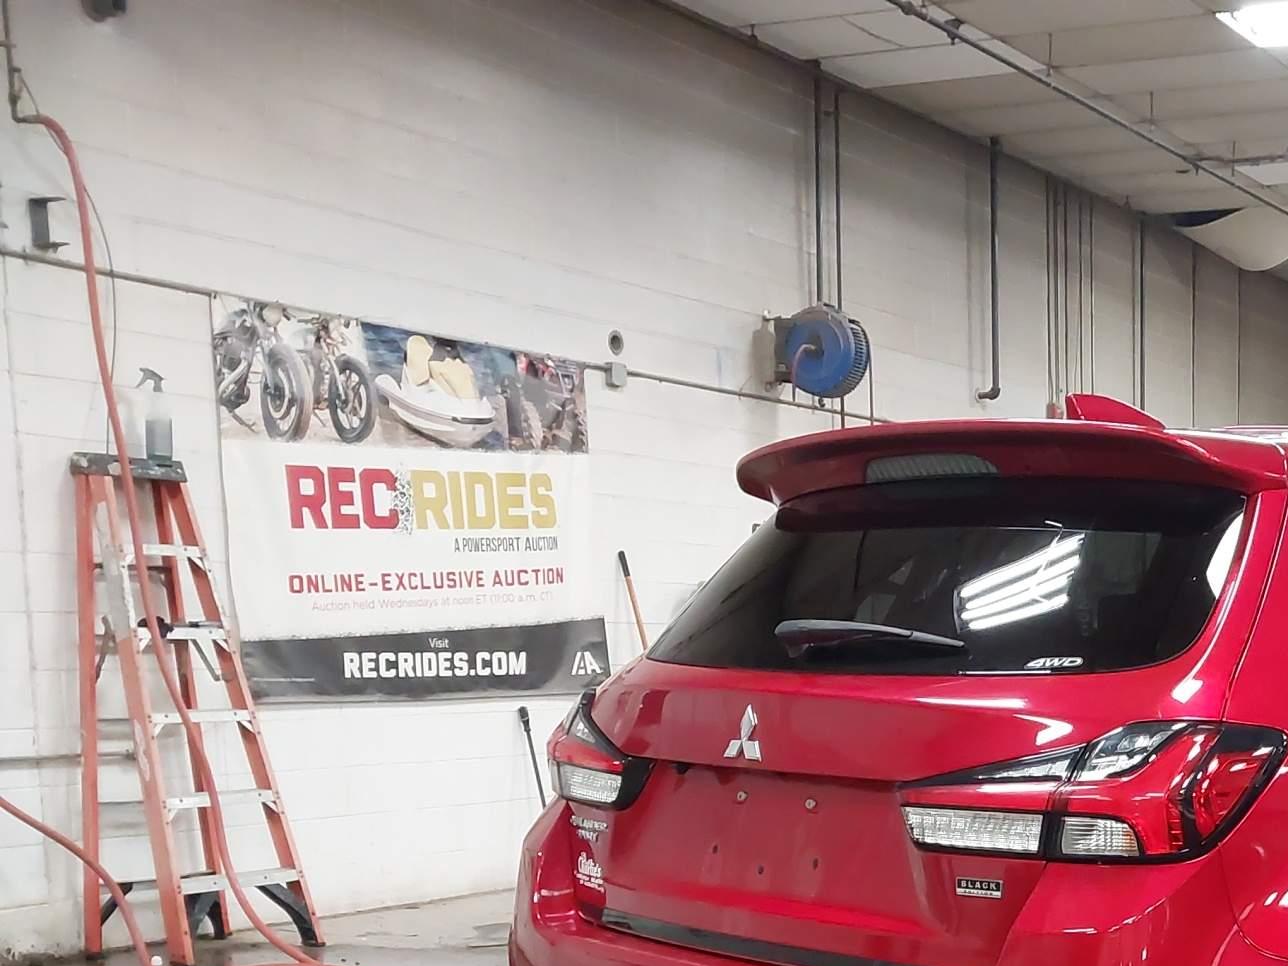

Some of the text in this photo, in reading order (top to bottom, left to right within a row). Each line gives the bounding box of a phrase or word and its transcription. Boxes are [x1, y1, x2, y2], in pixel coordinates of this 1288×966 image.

[285, 464, 558, 530] REC RIDES
[454, 536, 559, 553] A POWERSPORT AUCTION
[288, 567, 564, 594] ONLINE-EXCLUSIVE AUCTION
[428, 637, 450, 649] Visit
[343, 651, 527, 679] RECRIDES.COM
[1024, 656, 1084, 669] 4WD
[961, 880, 997, 890] BLACK
